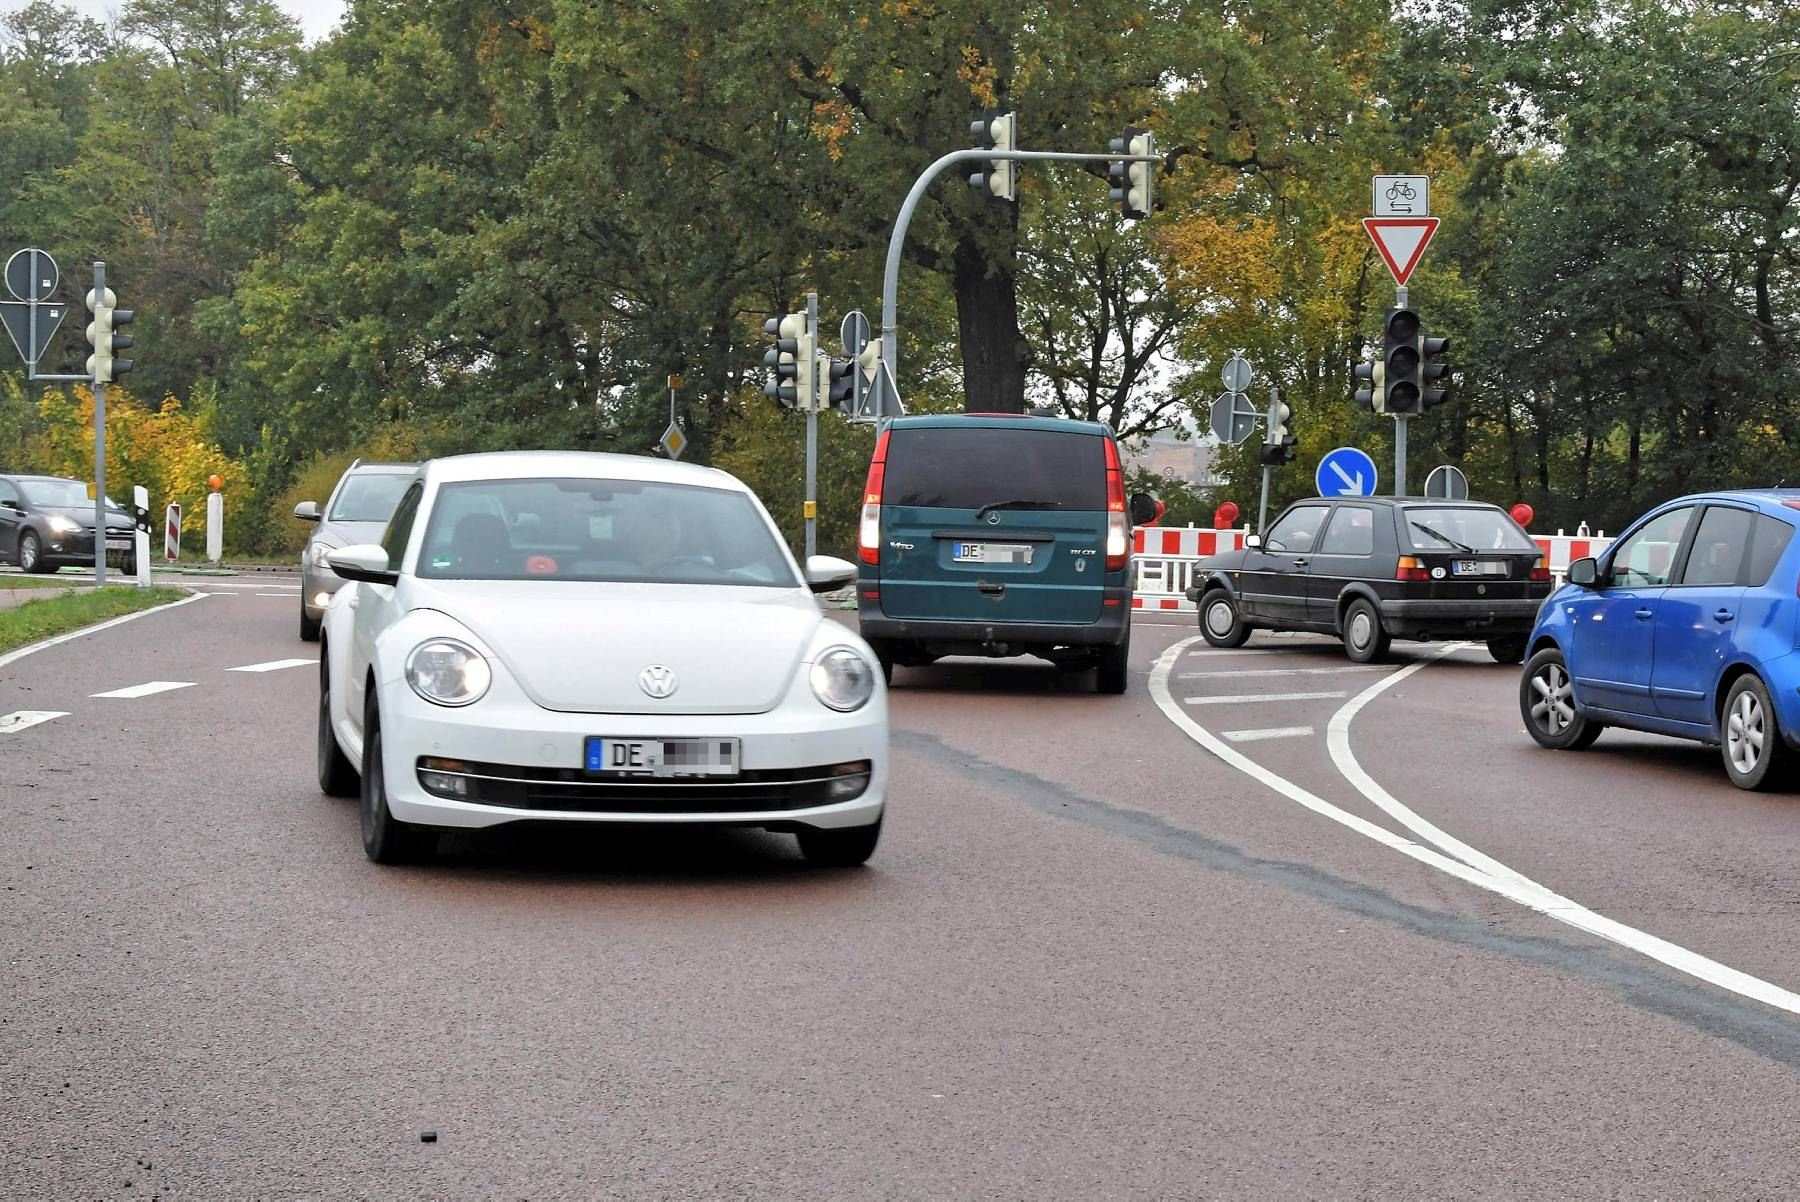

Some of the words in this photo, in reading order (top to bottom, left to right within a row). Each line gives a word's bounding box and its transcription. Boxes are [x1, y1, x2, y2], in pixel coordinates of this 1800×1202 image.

[962, 545, 978, 557] DE
[1461, 561, 1472, 571] DE
[612, 743, 643, 767] DE
